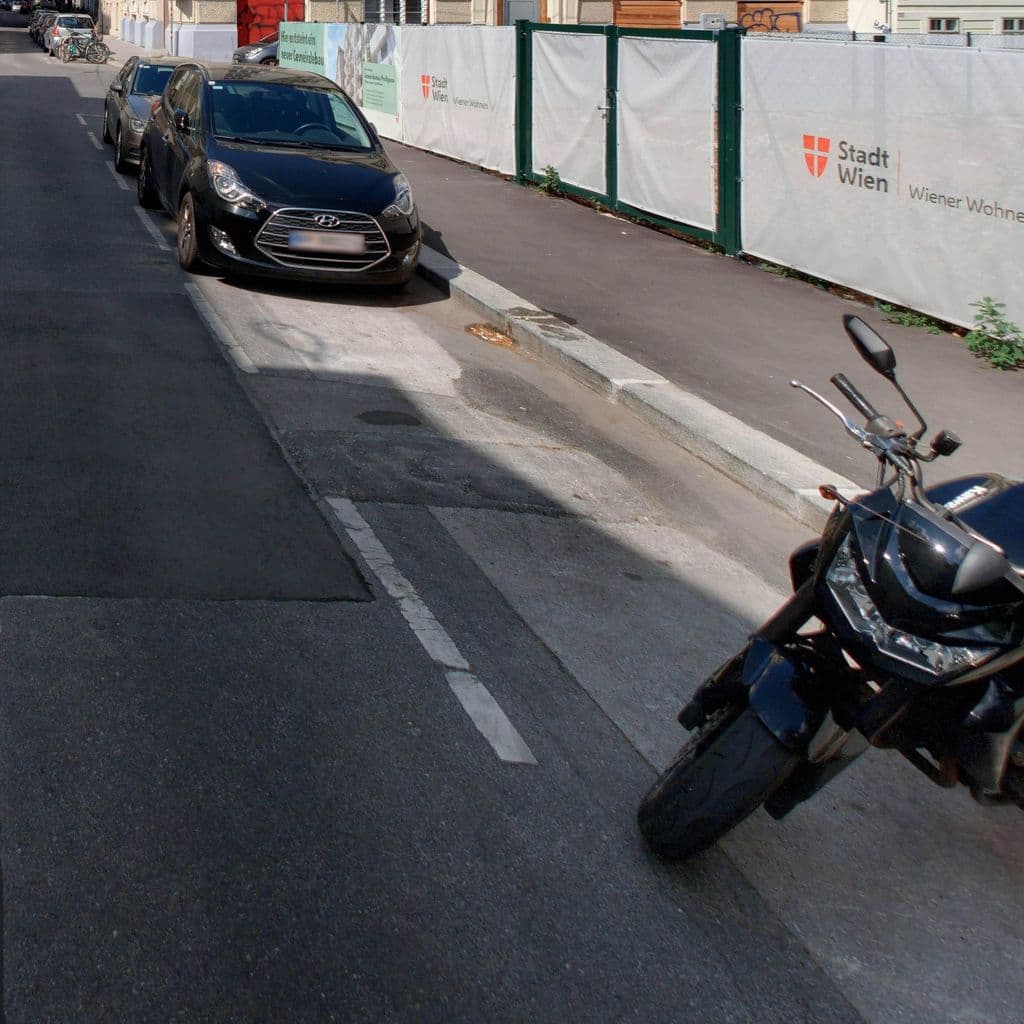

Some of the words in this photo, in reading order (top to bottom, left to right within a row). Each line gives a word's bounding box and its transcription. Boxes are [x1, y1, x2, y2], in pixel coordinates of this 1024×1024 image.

[432, 76, 448, 88] Stadt
[432, 89, 449, 103] Wien
[837, 140, 890, 169] Stadt
[837, 163, 889, 193] Wien
[908, 184, 963, 209] Wiener
